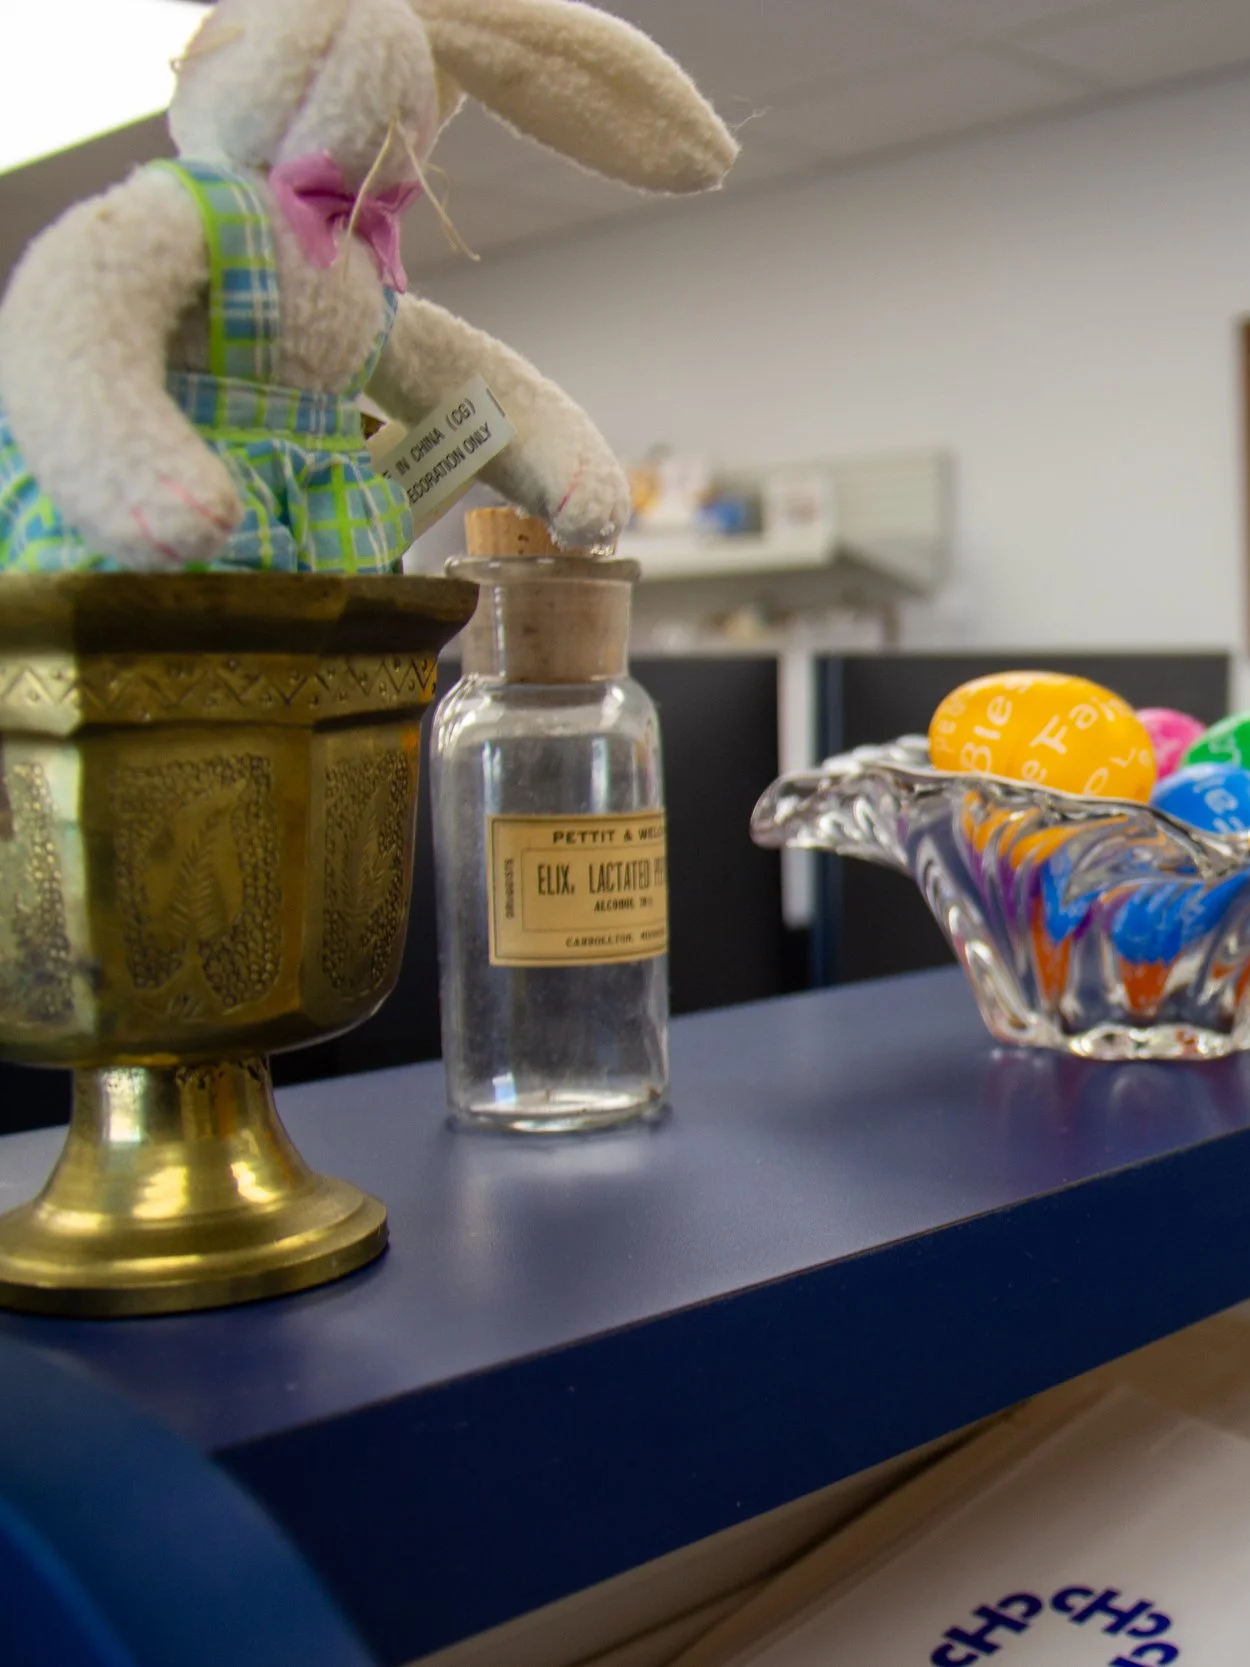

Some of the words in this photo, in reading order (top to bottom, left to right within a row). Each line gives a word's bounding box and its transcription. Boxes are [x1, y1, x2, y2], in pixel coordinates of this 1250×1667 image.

[410, 427, 446, 463] CHINA
[445, 398, 476, 431] (CG)
[406, 447, 467, 504] ECORATION
[462, 421, 493, 454] ONLY
[552, 830, 616, 844] PETTIT
[623, 829, 633, 843] &
[588, 859, 650, 895] LACTATED
[593, 898, 635, 912] ALCOHOL
